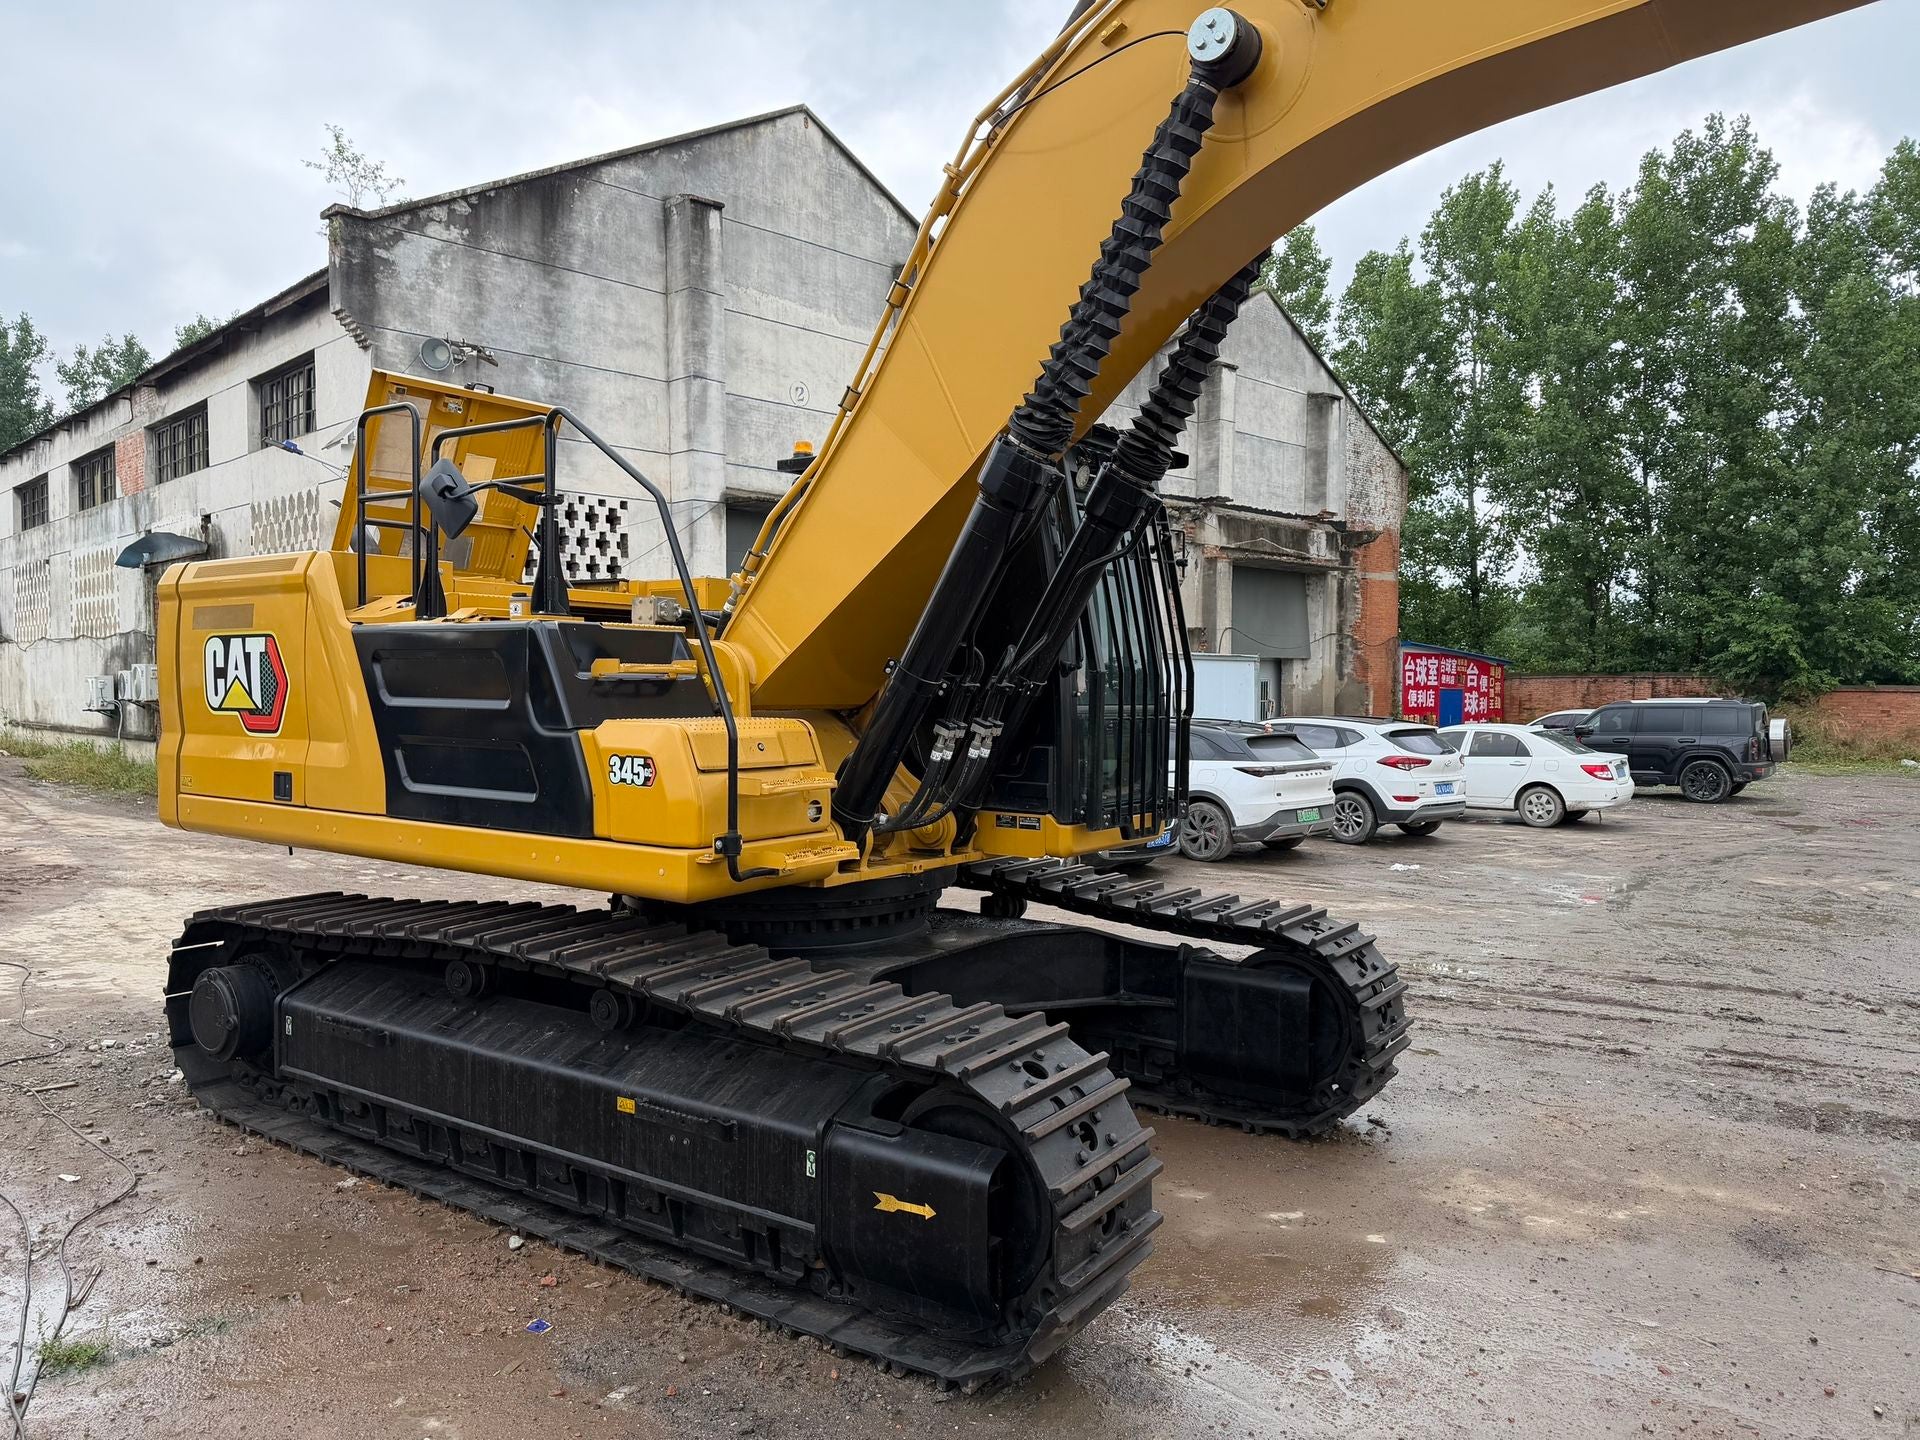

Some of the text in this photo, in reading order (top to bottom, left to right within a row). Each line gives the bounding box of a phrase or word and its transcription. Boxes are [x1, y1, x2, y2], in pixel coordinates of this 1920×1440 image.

[205, 636, 266, 709] CAT
[1405, 656, 1439, 686] 台球室
[1408, 689, 1436, 707] 便利店
[609, 755, 645, 785] 345
